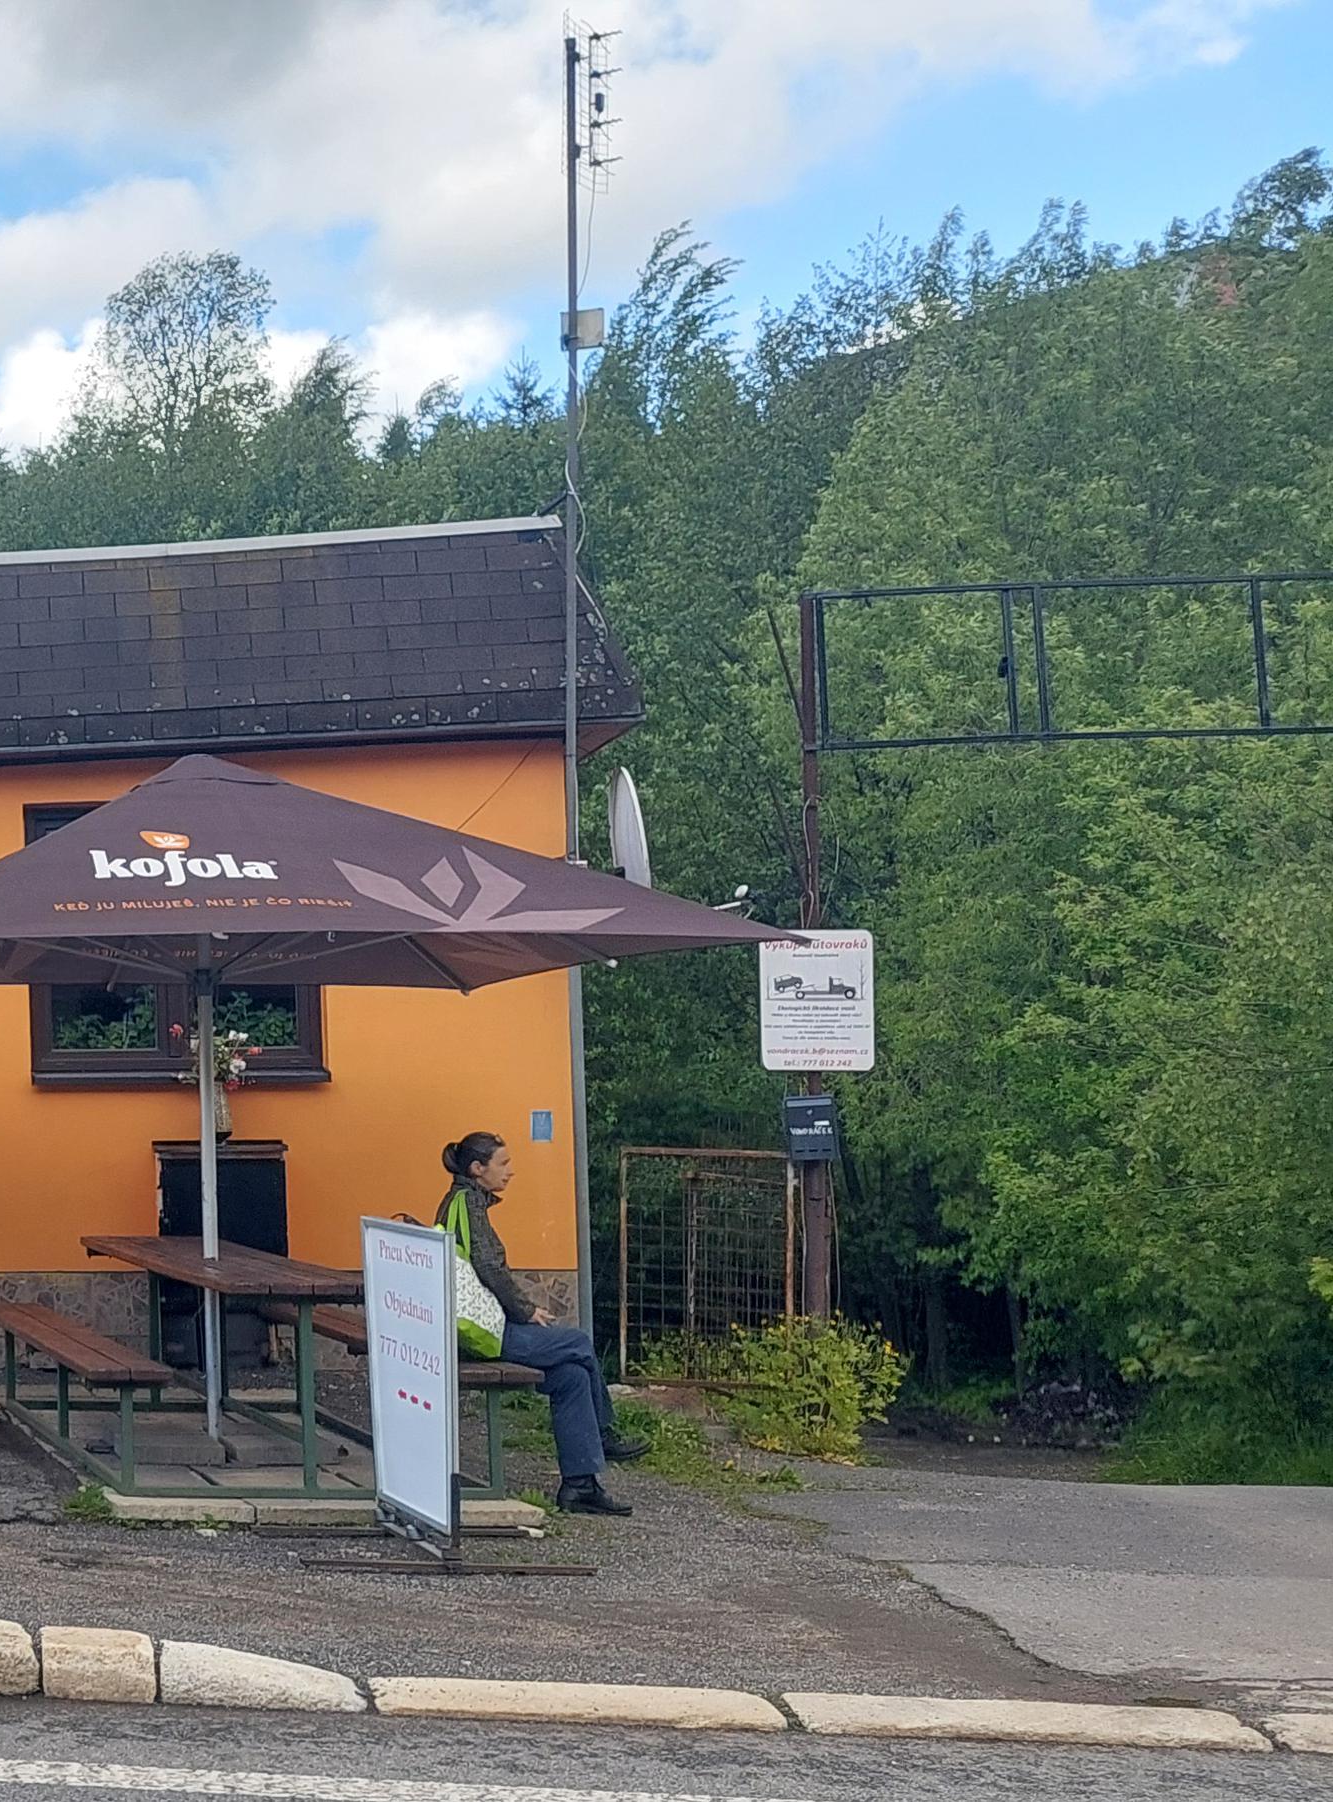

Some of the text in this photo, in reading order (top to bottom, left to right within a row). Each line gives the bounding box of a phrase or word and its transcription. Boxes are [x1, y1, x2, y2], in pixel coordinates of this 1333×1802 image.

[88, 849, 279, 887] kofola
[95, 900, 116, 912] JU
[205, 898, 237, 908] NIE
[242, 897, 261, 908] JE
[802, 1059, 818, 1067] 777
[379, 1239, 434, 1270] Pneu Servis
[379, 1334, 441, 1377] 777 012 242
